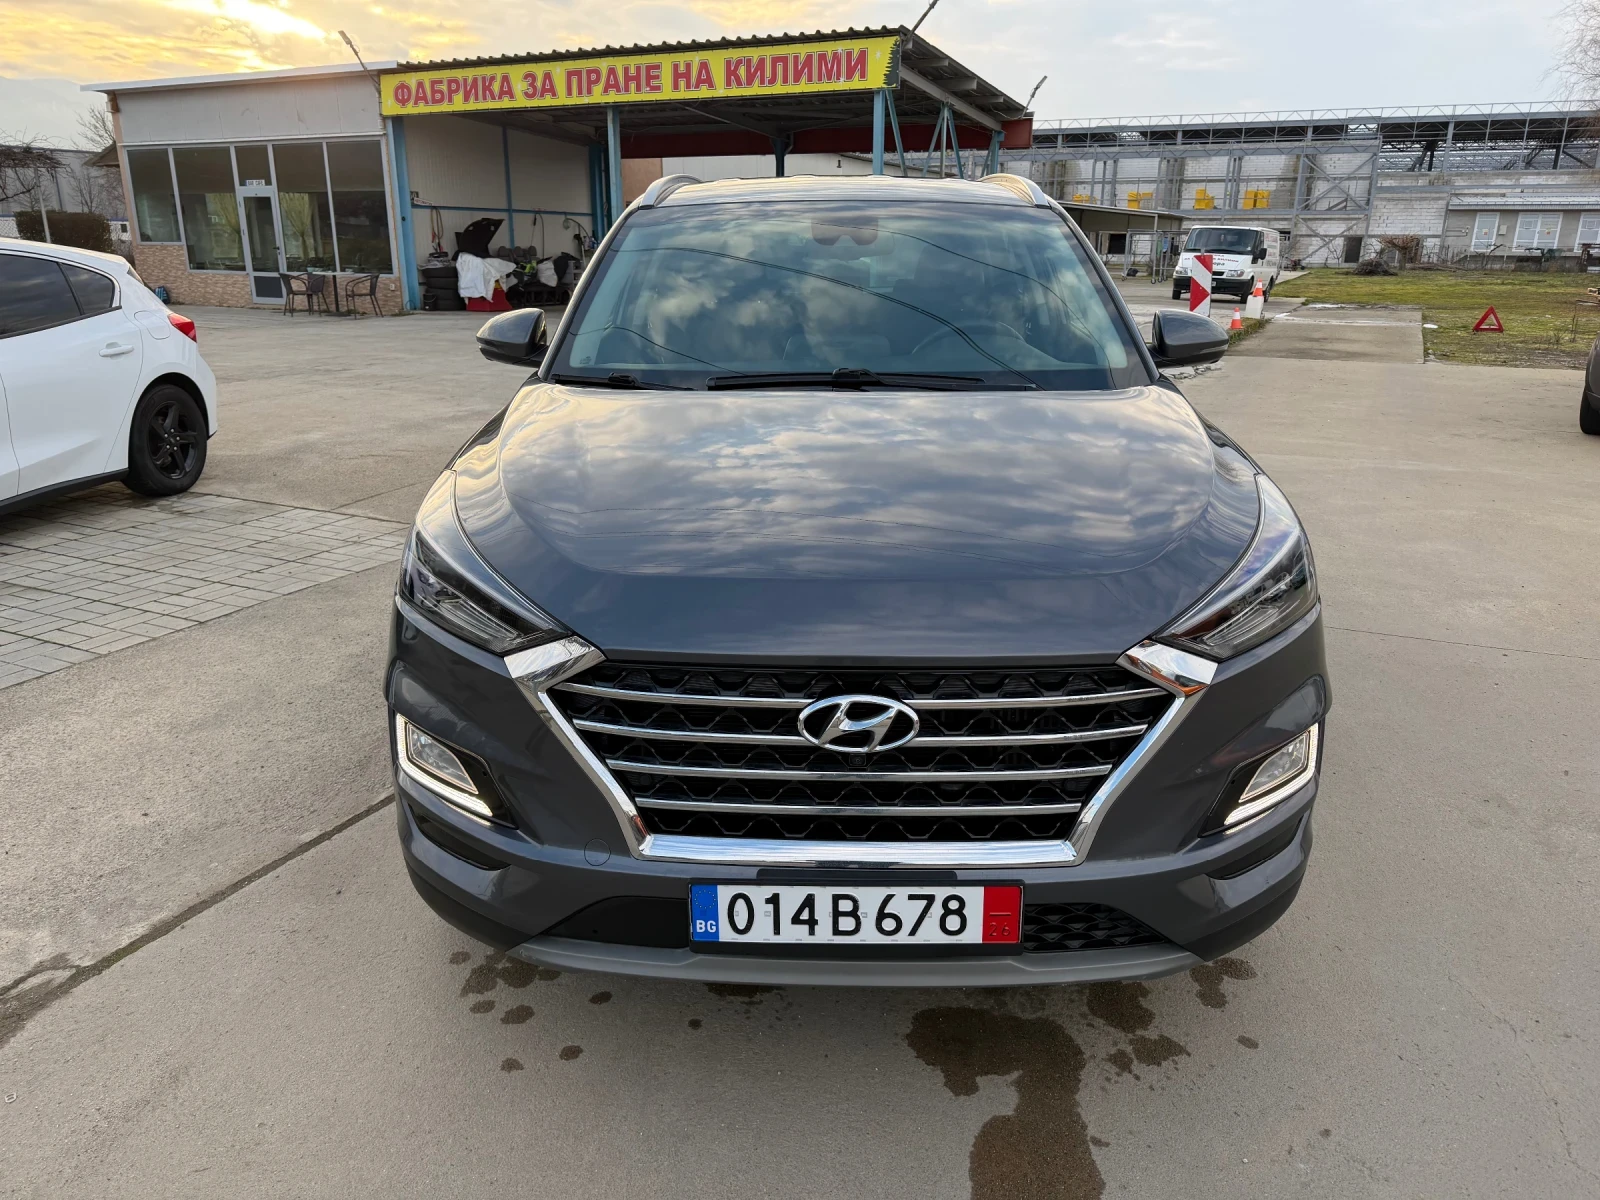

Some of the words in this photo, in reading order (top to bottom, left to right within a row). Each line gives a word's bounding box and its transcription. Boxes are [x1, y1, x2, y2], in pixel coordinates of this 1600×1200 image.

[394, 73, 515, 108] ФАБРИКА
[521, 70, 558, 100] ЗА
[565, 63, 663, 98] ПРАНЕ
[671, 59, 716, 92] НА
[724, 48, 868, 89] КИЛИМИ
[696, 920, 716, 933] BG
[727, 892, 967, 936] 014B678
[989, 922, 1011, 936] 26
